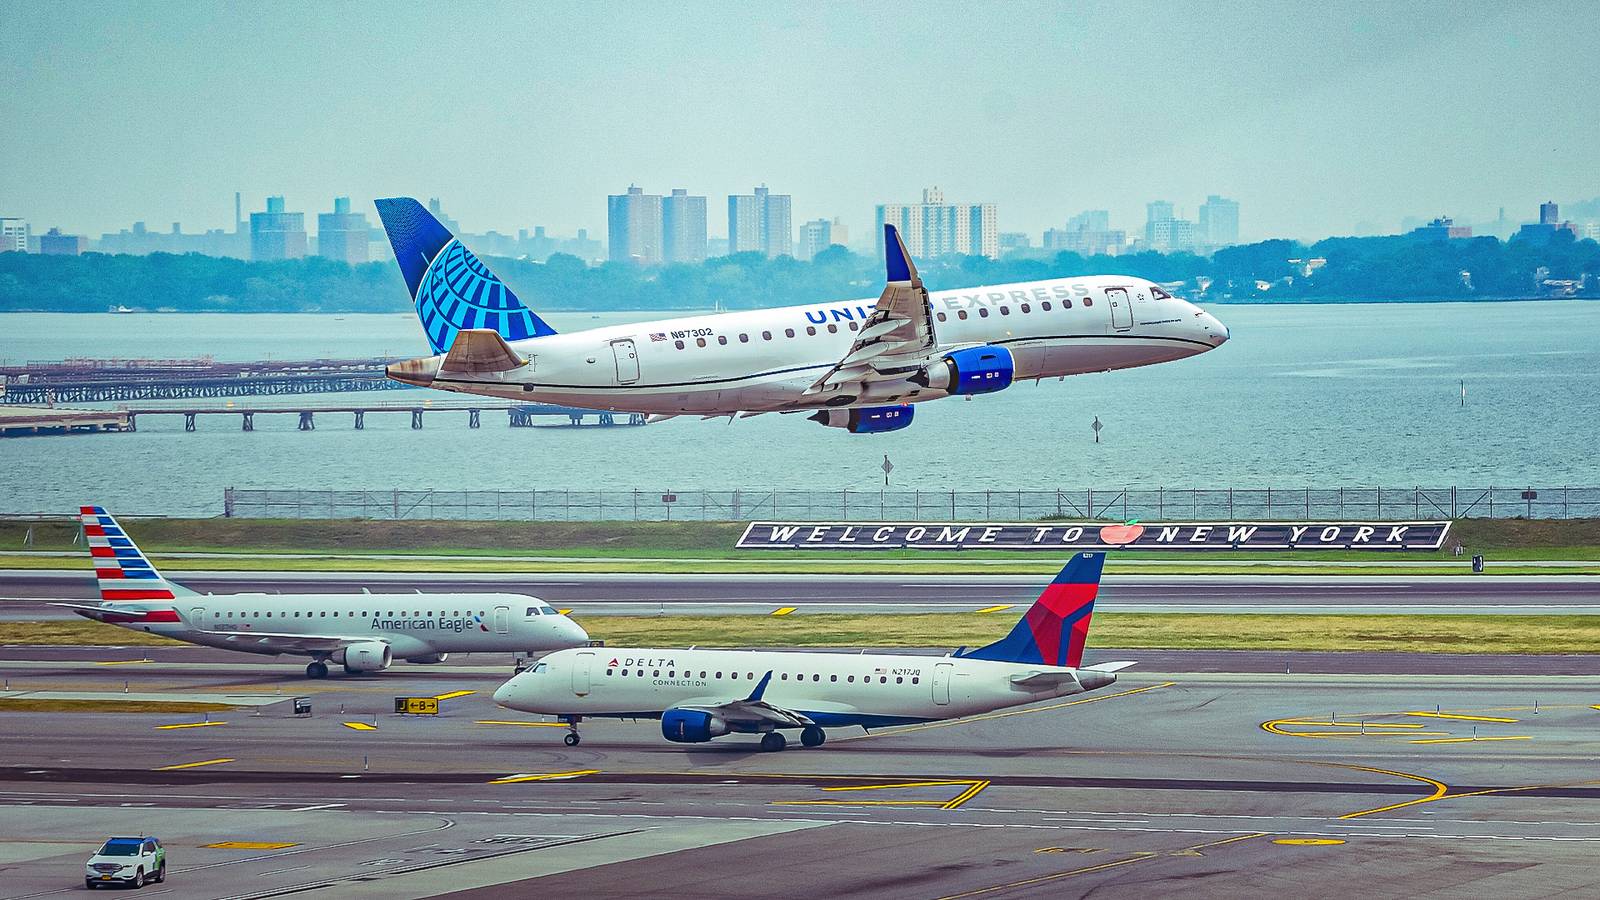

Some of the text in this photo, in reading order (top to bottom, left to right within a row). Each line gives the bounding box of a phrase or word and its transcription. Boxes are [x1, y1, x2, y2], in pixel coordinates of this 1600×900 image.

[805, 283, 1089, 324] UNI EXPRESS
[670, 327, 714, 340] N87302
[769, 525, 1411, 543] WELCOME TO NEW YORK
[371, 617, 474, 633] American Eagle
[624, 658, 675, 667] DELTA
[891, 668, 921, 676] N217JQ
[652, 679, 707, 687] CONNECTION
[419, 700, 426, 710] B
